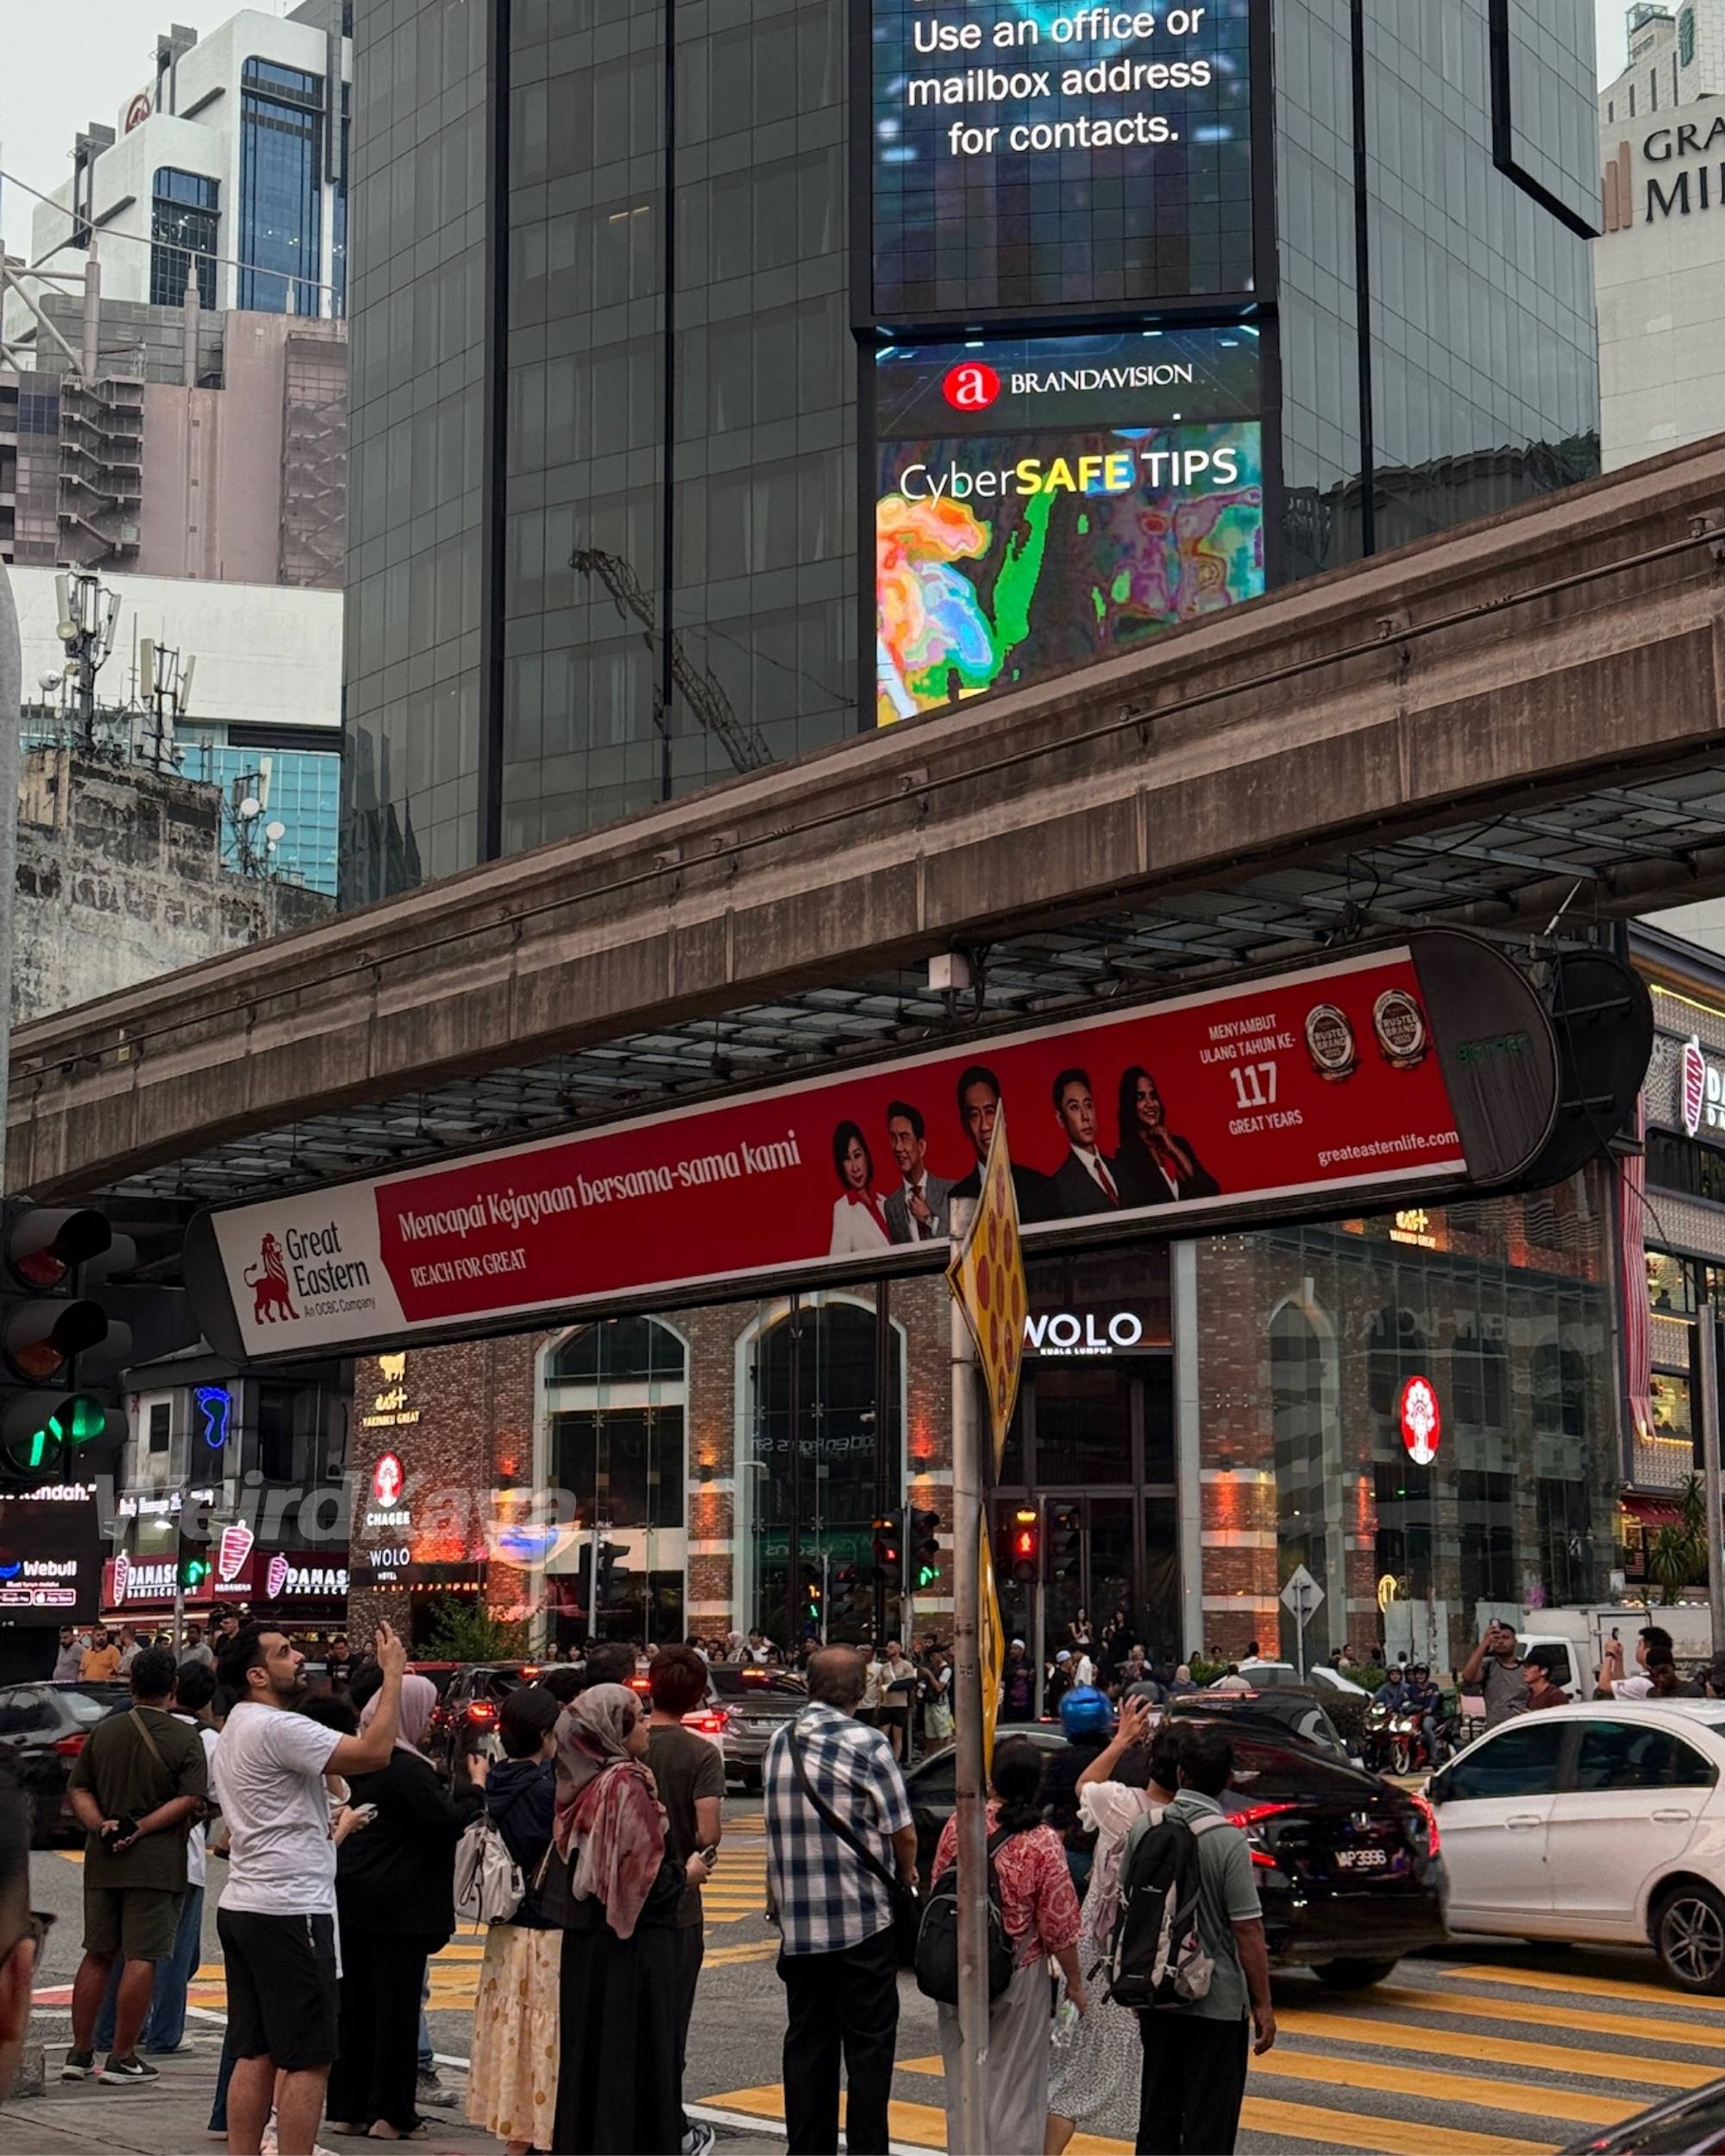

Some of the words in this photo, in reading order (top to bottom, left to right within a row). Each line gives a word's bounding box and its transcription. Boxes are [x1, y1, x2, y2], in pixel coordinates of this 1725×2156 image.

[913, 18, 982, 53] Use
[993, 20, 1038, 47] an
[1051, 9, 1155, 43] office
[1166, 7, 1205, 35] or
[908, 69, 1050, 106] mailbox
[1061, 59, 1211, 94] address
[949, 122, 999, 155] for
[1009, 112, 1179, 148] contacts.
[1011, 364, 1192, 394] BRANDAVISION
[900, 454, 1131, 510] CyberSAFE
[1141, 448, 1238, 488] TIPS
[1208, 1013, 1276, 1041] MENYAMBUT
[1200, 1044, 1237, 1064] ULANG
[1237, 1037, 1276, 1058] TAHUN
[1276, 1032, 1296, 1050] KE-
[1229, 1061, 1277, 1109] 117
[1229, 1114, 1264, 1137] GREAT
[1265, 1109, 1304, 1131] YEARS
[1318, 1130, 1459, 1168] greateasternlife.com
[398, 1194, 487, 1242] Mencapai
[487, 1184, 578, 1230] Kejayaan
[577, 1150, 741, 1206] bersama-sama
[741, 1129, 801, 1174] kami
[286, 1220, 342, 1261] Great
[293, 1260, 371, 1297] Eastern
[411, 1261, 455, 1288] REACH
[455, 1257, 484, 1282] FOR
[483, 1249, 527, 1275] GREAT
[304, 1304, 316, 1318] An
[339, 1297, 375, 1312] Company
[1024, 1313, 1142, 1347] WOLO
[1040, 1347, 1072, 1357] KUALA
[1074, 1346, 1113, 1356] LUMPUR
[367, 1511, 411, 1526] CHAGEE
[23, 1560, 77, 1576] Webull
[369, 1548, 411, 1567] WOLO
